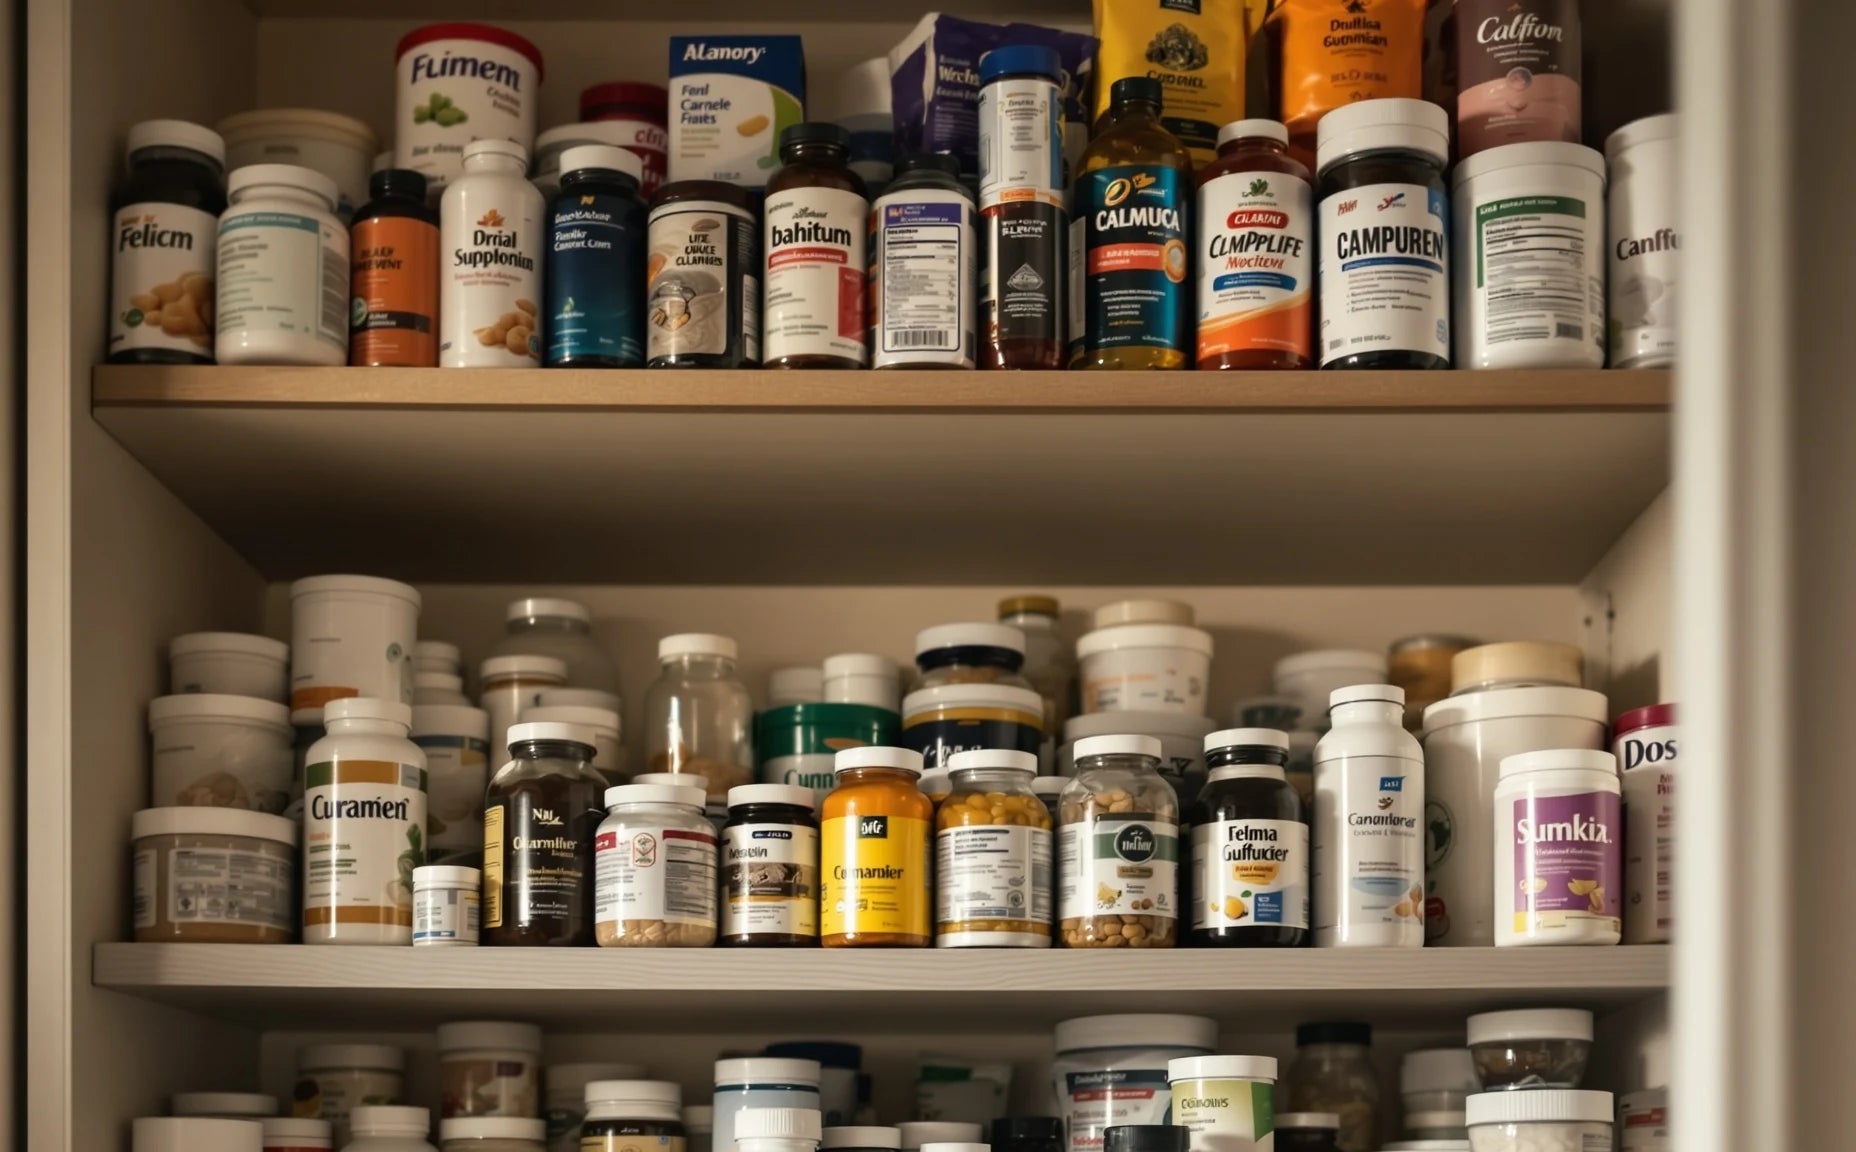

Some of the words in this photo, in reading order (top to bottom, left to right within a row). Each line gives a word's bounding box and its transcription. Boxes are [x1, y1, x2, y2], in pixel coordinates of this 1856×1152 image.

[1096, 206, 1181, 232] CALMUCA
[772, 221, 852, 248] bahitum
[1337, 226, 1443, 261] CAMPUREN
